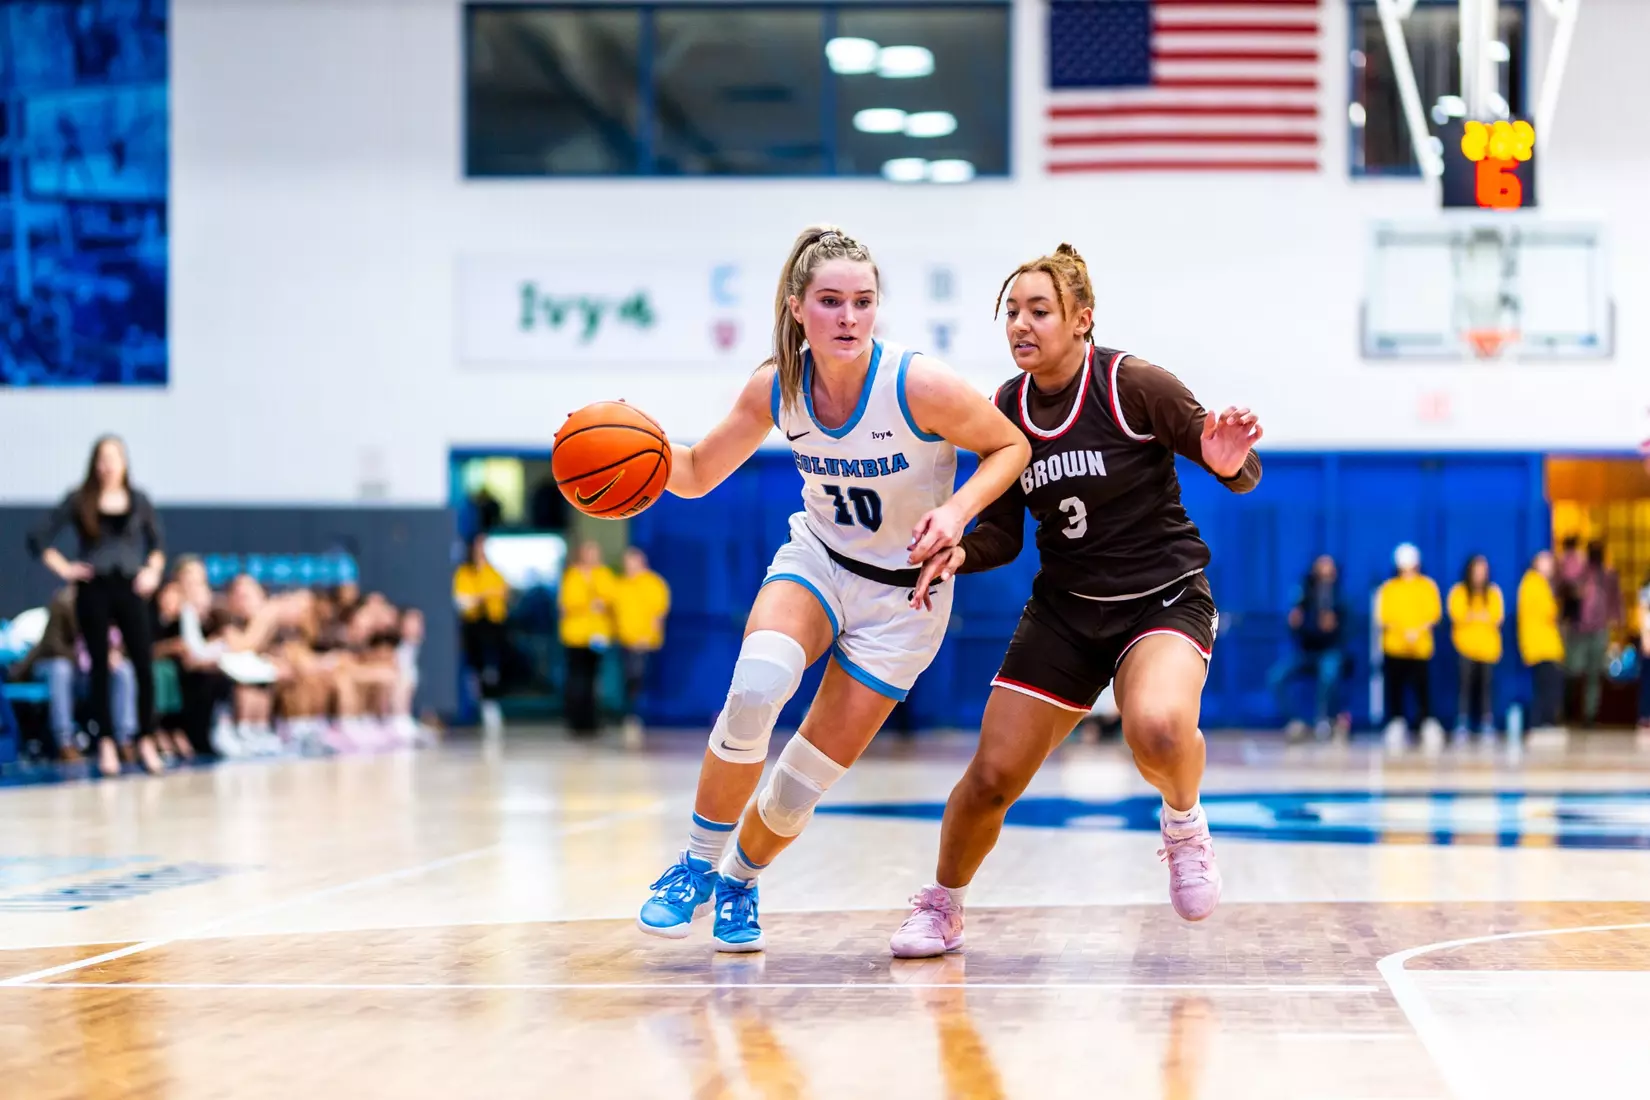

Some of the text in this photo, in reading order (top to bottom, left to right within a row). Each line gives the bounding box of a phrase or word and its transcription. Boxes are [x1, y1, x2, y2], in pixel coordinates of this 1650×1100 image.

[519, 281, 604, 343] Ivy
[1020, 450, 1107, 495] BROWN
[821, 484, 883, 533] 10
[1058, 496, 1088, 540] 3
